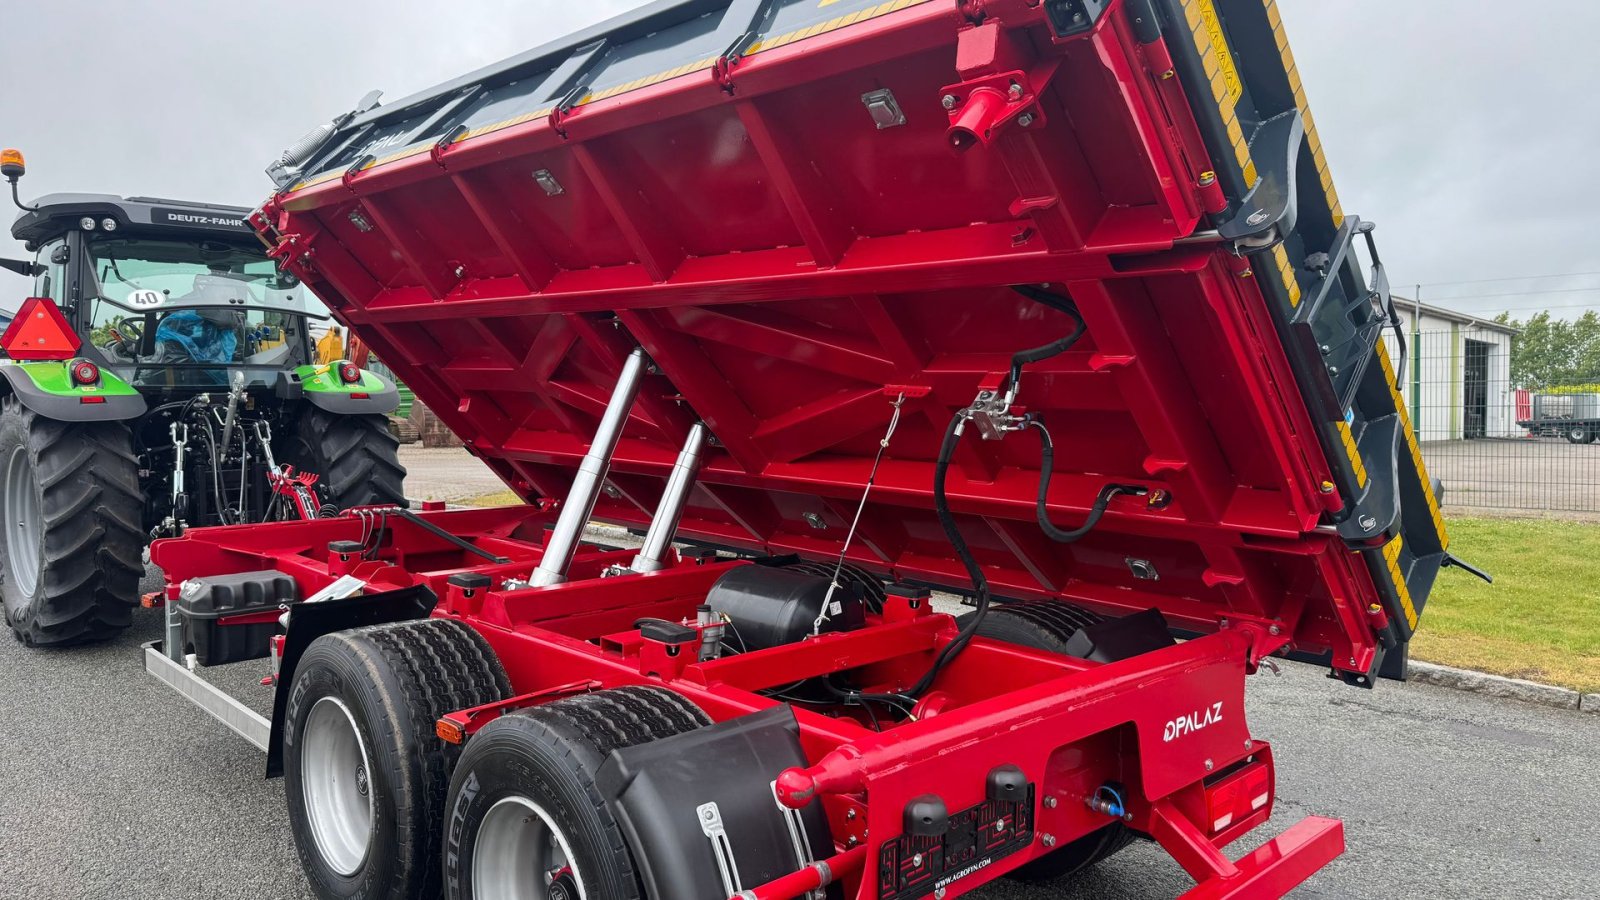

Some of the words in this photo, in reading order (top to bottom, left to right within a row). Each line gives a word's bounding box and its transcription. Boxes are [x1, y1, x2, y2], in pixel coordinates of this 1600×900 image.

[168, 213, 243, 226] DEUTZ-FAHR
[135, 292, 159, 304] 40
[935, 857, 991, 889] WWW.AGROFYN.COM
